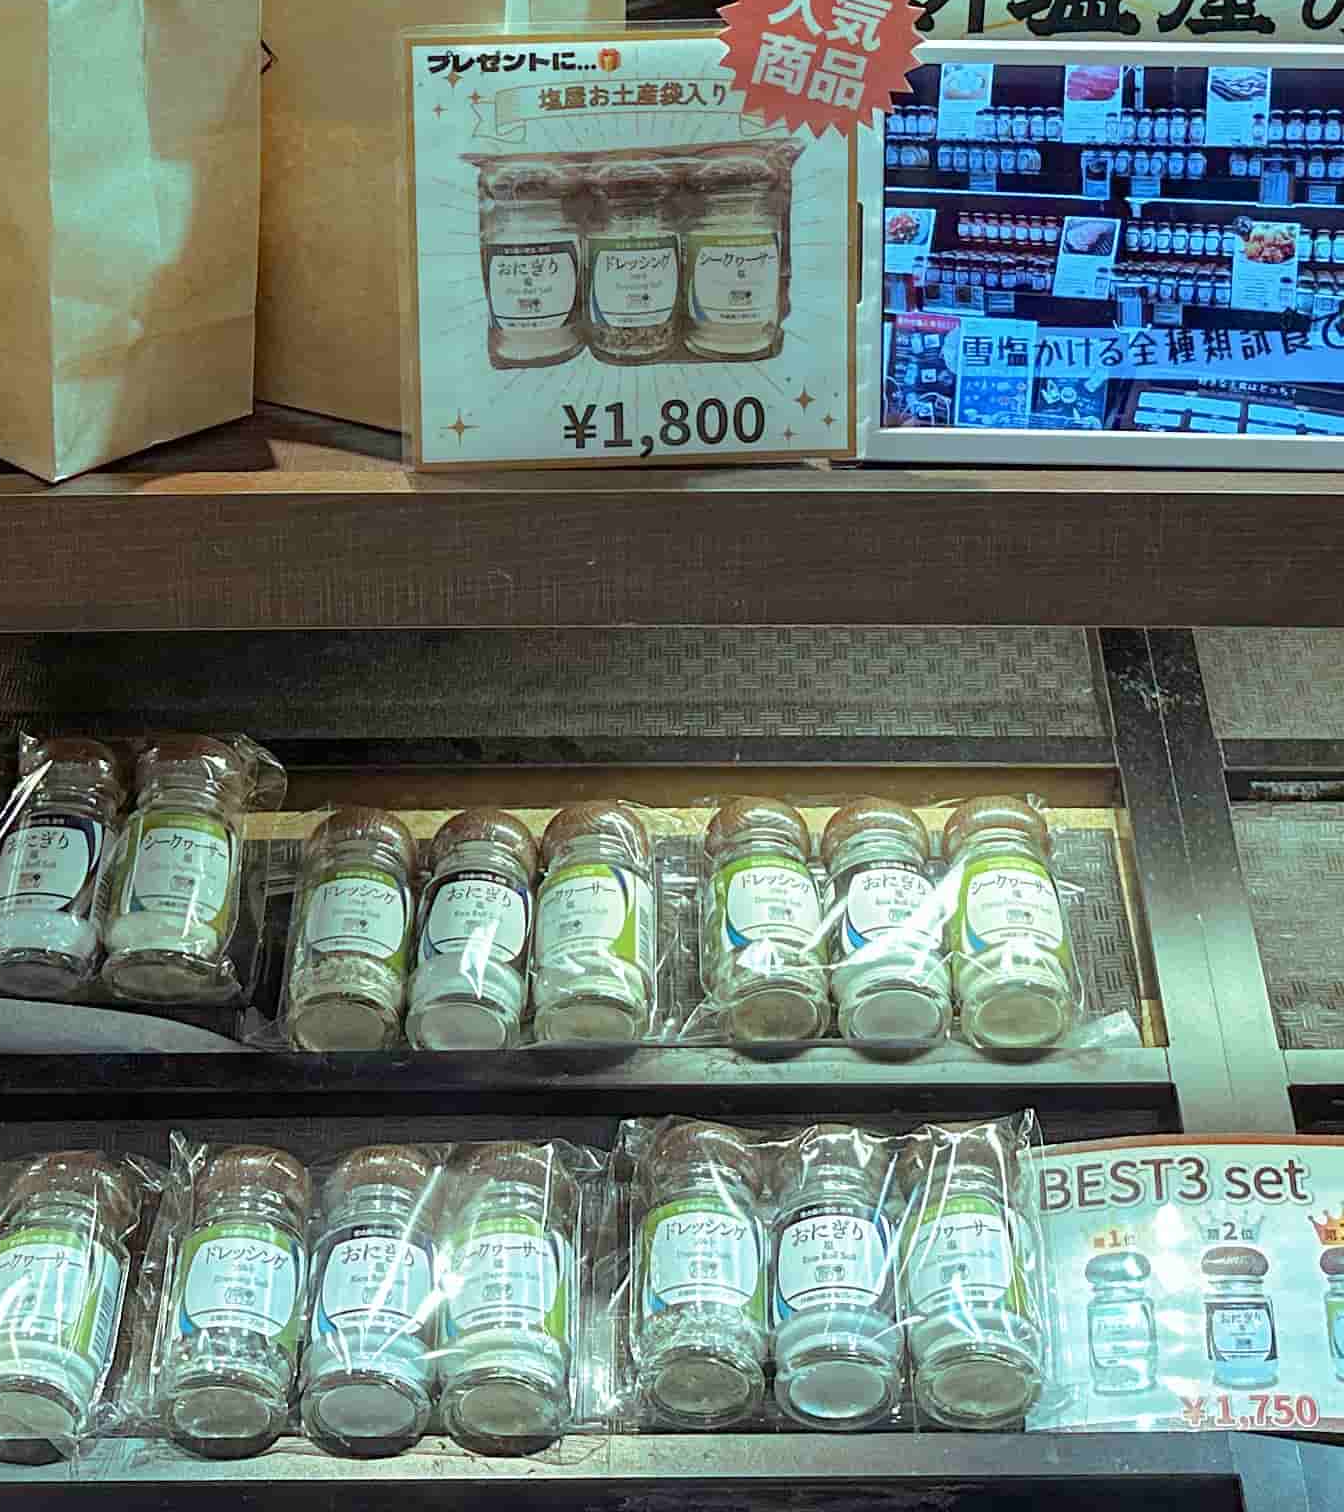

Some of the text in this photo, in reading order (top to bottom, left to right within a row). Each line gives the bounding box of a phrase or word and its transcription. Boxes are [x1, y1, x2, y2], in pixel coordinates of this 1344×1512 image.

[751, 33, 874, 111] 商品
[563, 397, 766, 457] ¥1,800
[1040, 1156, 1309, 1210] BEST3 set
[1182, 1394, 1320, 1427] ¥1,750
